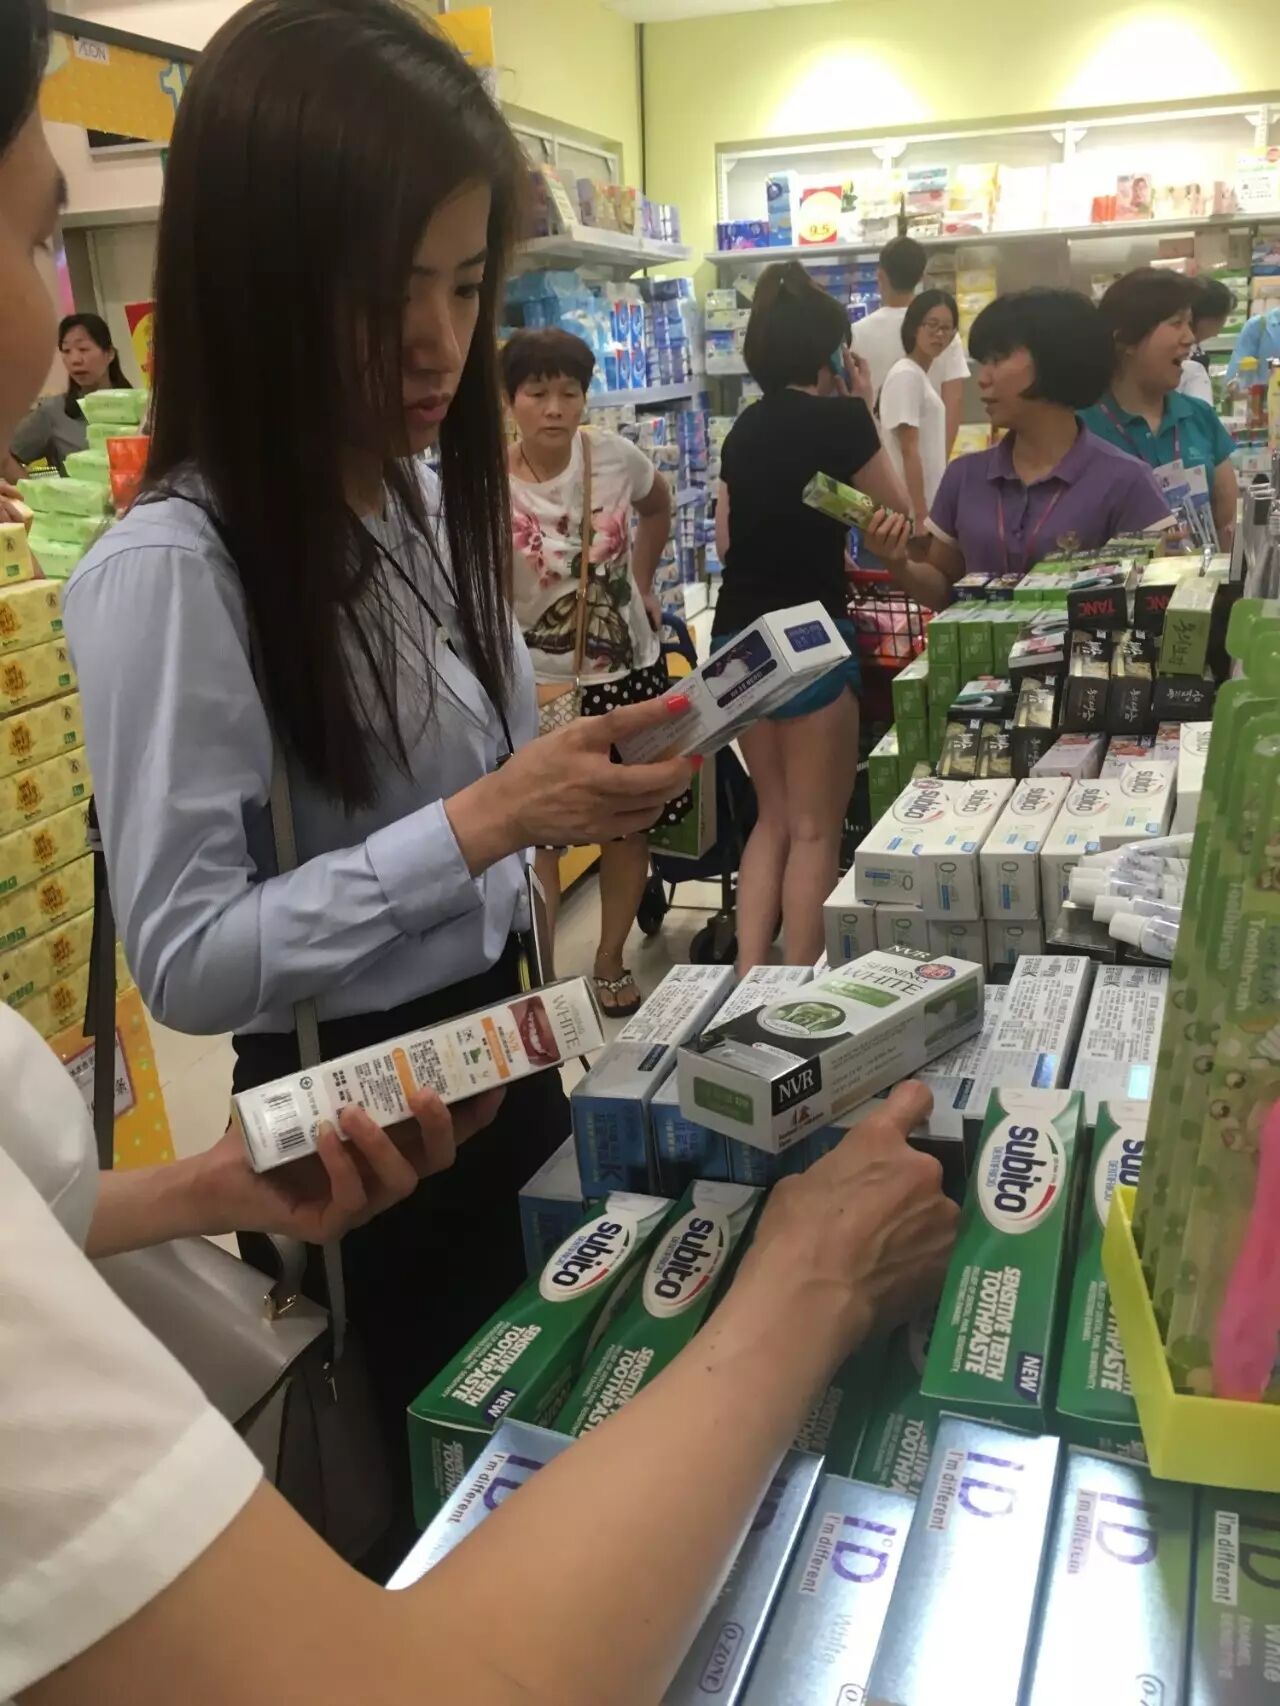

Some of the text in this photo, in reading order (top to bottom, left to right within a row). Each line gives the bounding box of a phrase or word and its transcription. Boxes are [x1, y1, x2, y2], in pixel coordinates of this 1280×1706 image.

[904, 790, 941, 819] subito
[1020, 787, 1046, 811] subito
[842, 967, 924, 996] WHITE
[1235, 918, 1266, 1011] Toothbrush
[551, 994, 582, 1051] WHITE
[779, 1070, 815, 1103] NVR
[994, 1125, 1047, 1213] subito
[552, 1221, 623, 1287] subito
[655, 1217, 715, 1299] subito
[964, 1270, 1004, 1375] TOOTHPASTE
[985, 1266, 1021, 1382] SENSITIVE TEETH
[451, 1325, 526, 1401] TOOTHPASTE
[464, 1324, 542, 1407] SENSITIVE TEETH
[1020, 1355, 1041, 1393] NEW
[488, 1389, 517, 1418] NEW
[449, 1453, 506, 1523] I'm different
[890, 1419, 924, 1492] TOOTHPA
[958, 1451, 1024, 1518] ID
[929, 1451, 965, 1531] I'm different
[1218, 1513, 1237, 1537] I'm
[801, 1514, 841, 1593] I'm different
[832, 1515, 897, 1584] ID
[1095, 1492, 1160, 1565] ID
[1215, 1537, 1237, 1601] different
[707, 1627, 738, 1686] O-ZONE
